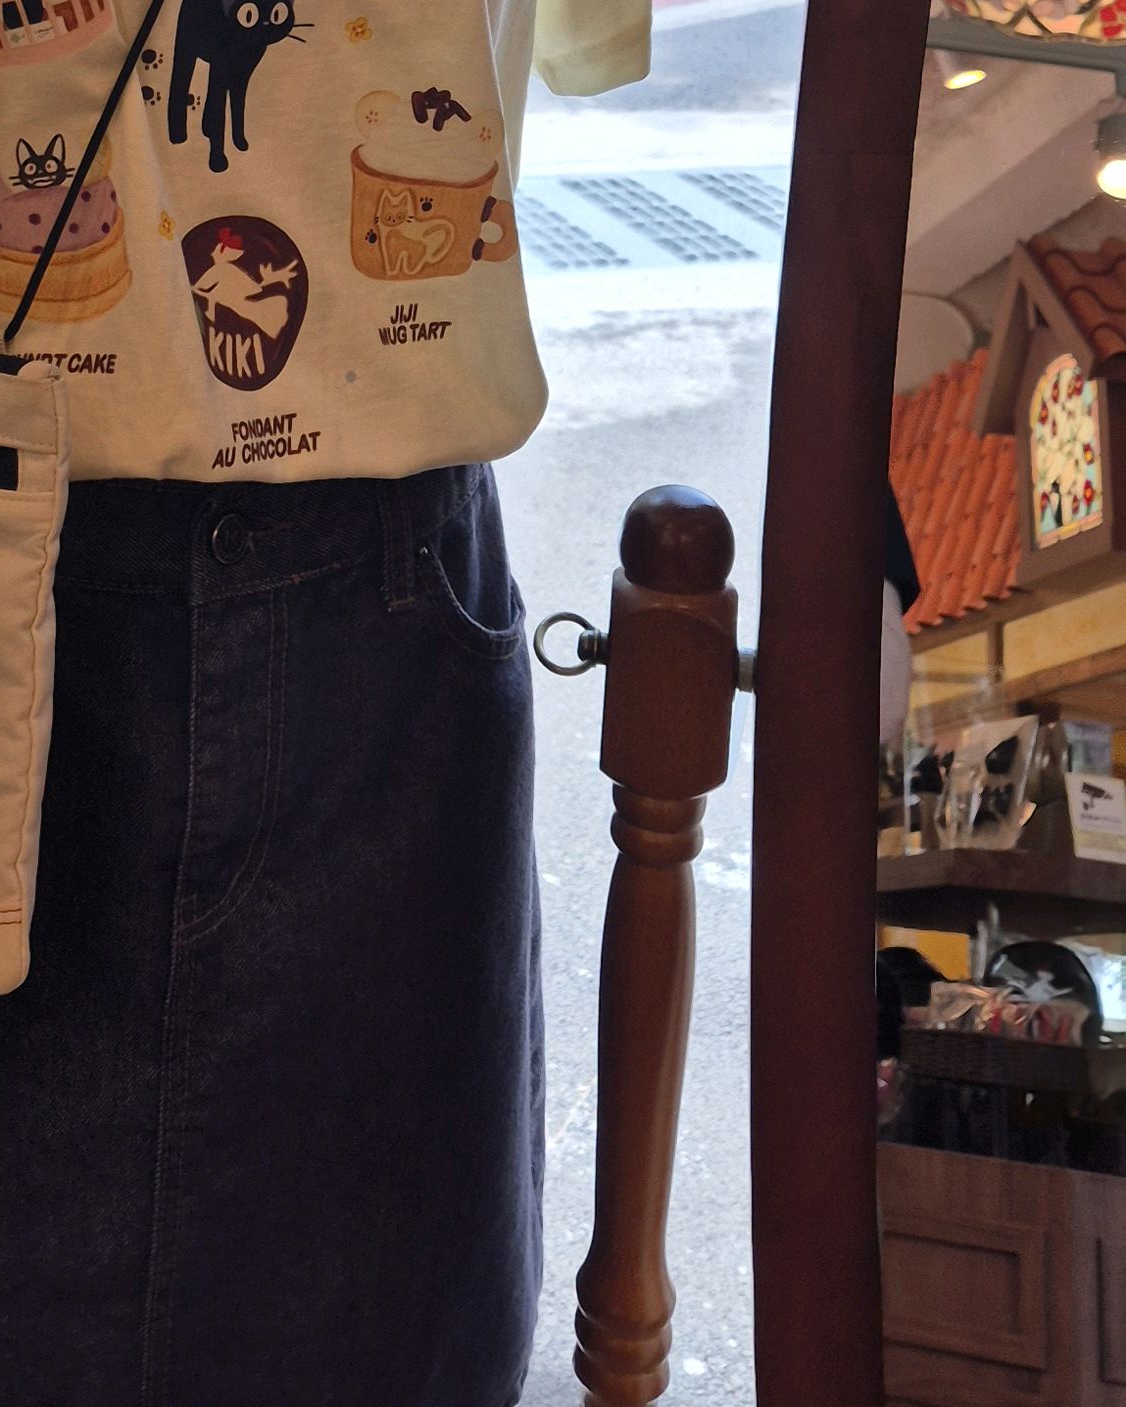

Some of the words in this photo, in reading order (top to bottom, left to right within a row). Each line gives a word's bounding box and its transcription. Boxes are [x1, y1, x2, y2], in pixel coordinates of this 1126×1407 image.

[390, 303, 418, 324] JIJI
[409, 321, 452, 342] TART
[67, 353, 117, 373] CAKE
[209, 326, 265, 378] KIKI
[231, 413, 297, 442] FONDANT
[212, 446, 236, 469] AU
[242, 431, 321, 464] CHOCOLAT
